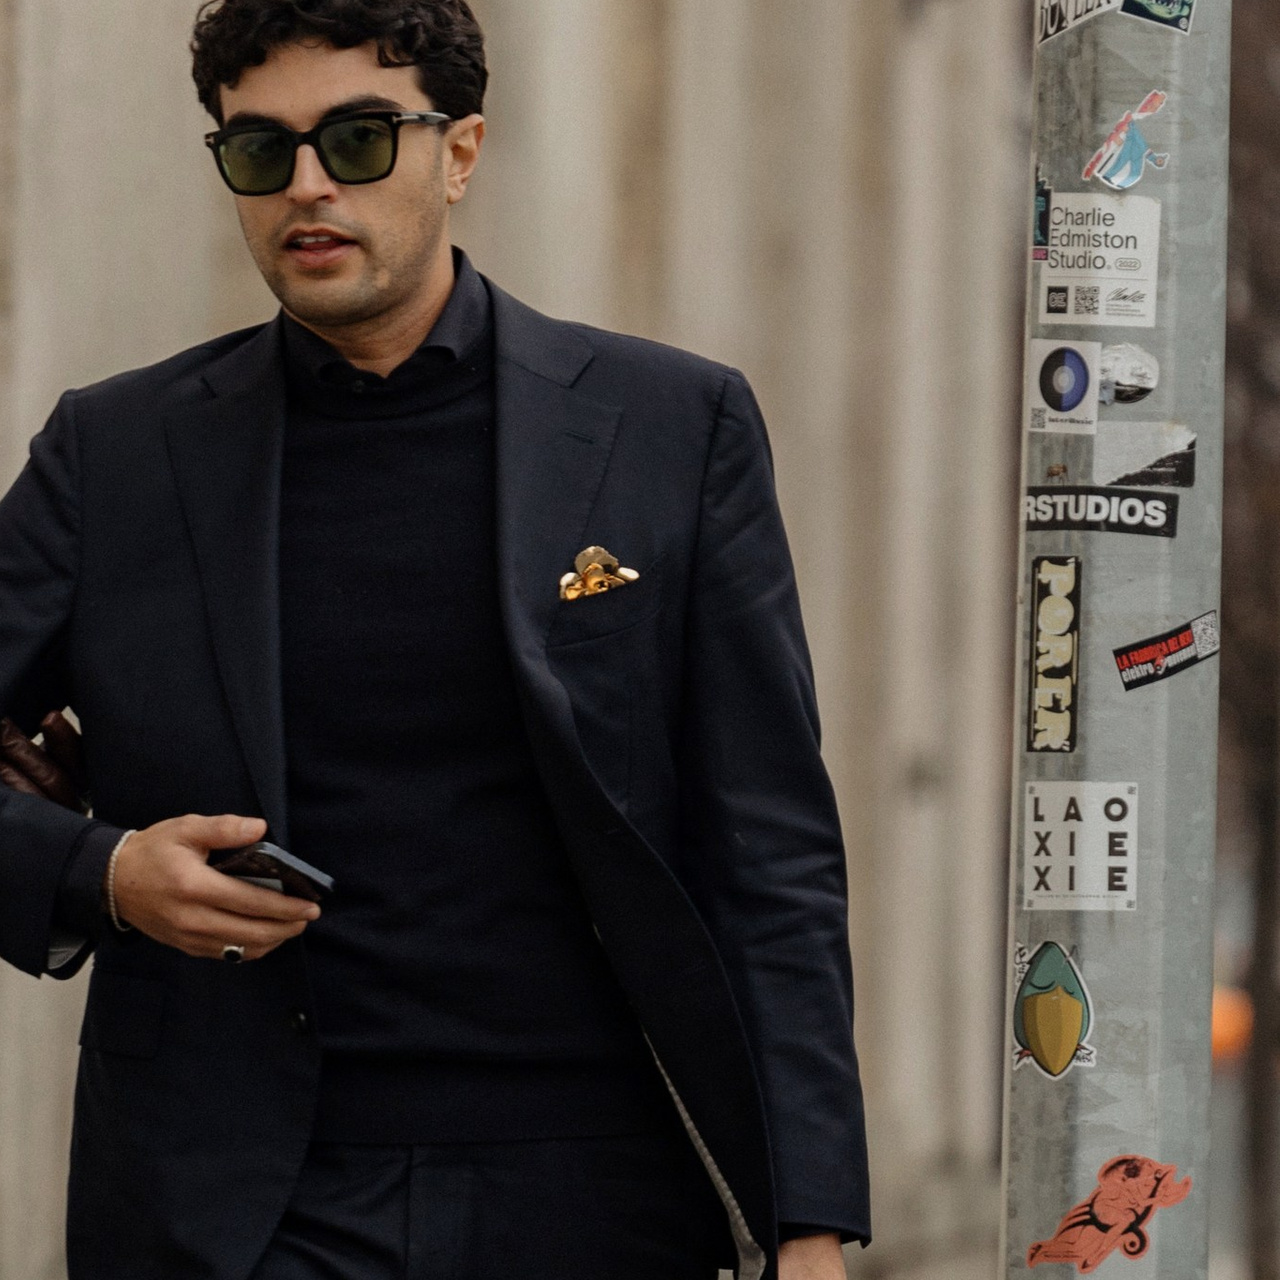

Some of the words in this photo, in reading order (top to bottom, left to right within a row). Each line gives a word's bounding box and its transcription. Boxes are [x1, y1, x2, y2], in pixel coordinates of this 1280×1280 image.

[1051, 207, 1115, 227] Charlie
[1050, 228, 1137, 250] Edmiston
[1034, 797, 1128, 822] LAO
[1034, 831, 1128, 857] XIE
[1033, 865, 1127, 891] XIE
